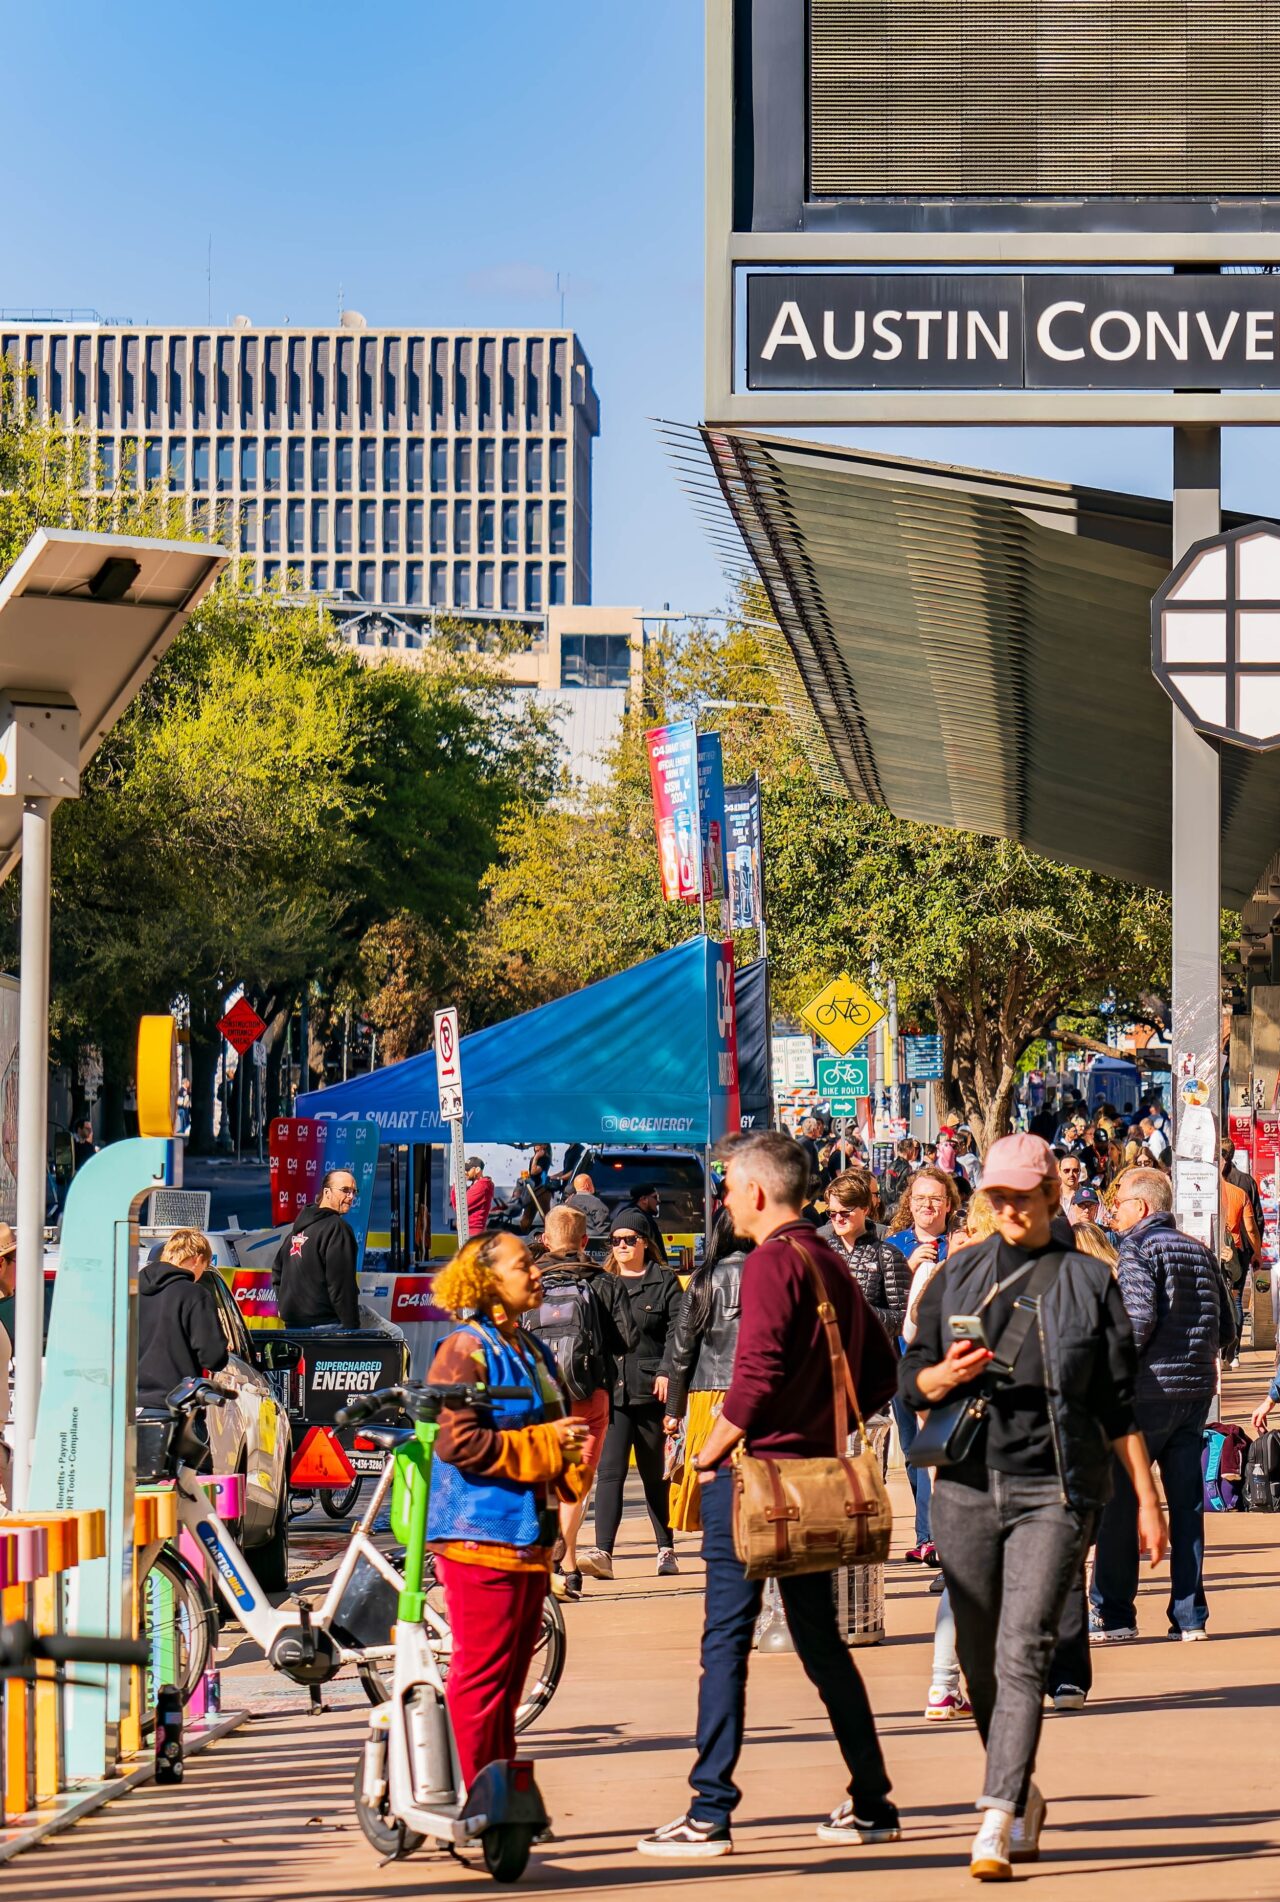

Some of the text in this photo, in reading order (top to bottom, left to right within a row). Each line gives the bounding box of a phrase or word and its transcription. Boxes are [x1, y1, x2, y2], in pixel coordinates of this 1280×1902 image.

[760, 300, 1009, 361] AUSTIN
[822, 1086, 865, 1095] BIKE ROUTE
[365, 1111, 418, 1129] SMART
[420, 1111, 474, 1129] ENEY
[619, 1117, 694, 1132] @C4ENERGY
[278, 1124, 289, 1135] C4
[297, 1125, 308, 1136] C4
[317, 1126, 327, 1137] C4
[336, 1127, 347, 1138] C4
[356, 1128, 367, 1139] C4
[269, 1156, 279, 1168] C4
[287, 1158, 298, 1169] C4
[306, 1160, 316, 1171] C4
[363, 1162, 374, 1173] C4
[152, 1163, 165, 1180] J
[279, 1191, 289, 1202] C4
[296, 1193, 307, 1204] C4
[234, 1287, 257, 1301] C4
[397, 1293, 420, 1307] C4
[315, 1361, 382, 1371] SUPERCHARGED
[312, 1371, 381, 1391] ENERGY
[68, 1406, 79, 1462] Compliance
[56, 1431, 68, 1509] Benefits Payroll
[350, 1459, 383, 1470] 2-436-3286
[67, 1469, 75, 1493] Tools
